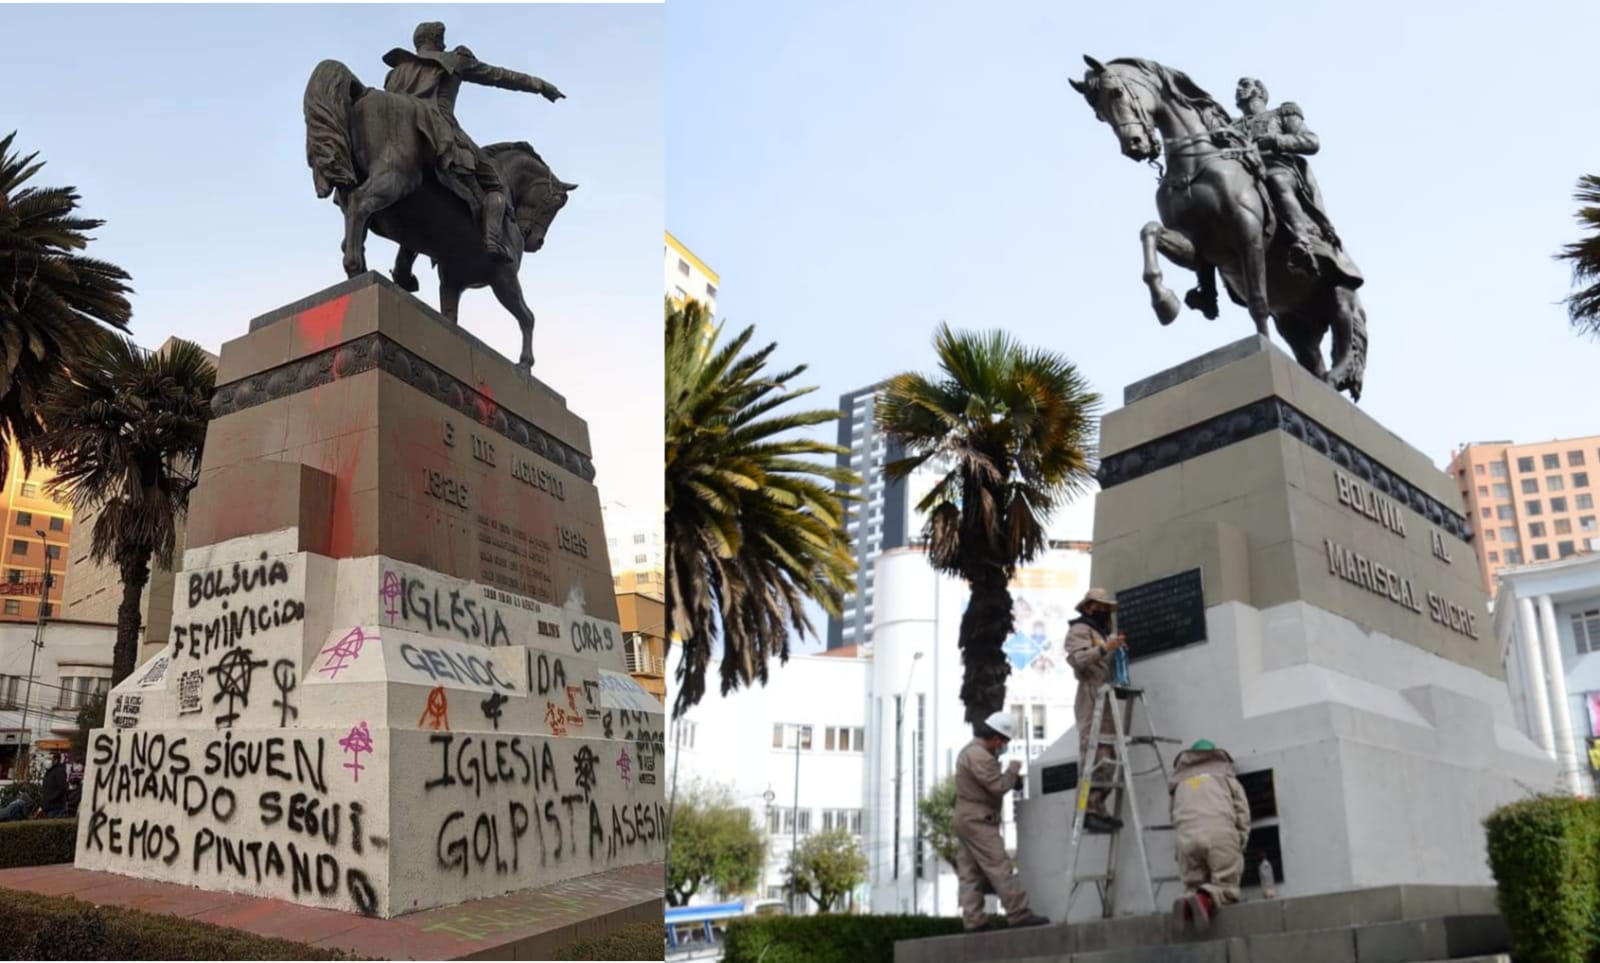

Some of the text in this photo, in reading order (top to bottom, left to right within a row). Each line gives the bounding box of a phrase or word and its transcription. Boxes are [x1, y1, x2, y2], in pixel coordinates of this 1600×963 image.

[511, 454, 567, 501] AGOSTO
[1334, 470, 1453, 564] BOLIVIA AL
[400, 575, 512, 647] IGLESIA
[1324, 538, 1480, 640] MARISCAL SUCRE
[92, 763, 237, 823] MATANDO
[131, 731, 191, 775] NOS
[204, 731, 328, 796] SIGUEN
[424, 735, 558, 799] IGLESIA
[86, 803, 180, 867] REMOS
[193, 827, 379, 915] PINTANDO
